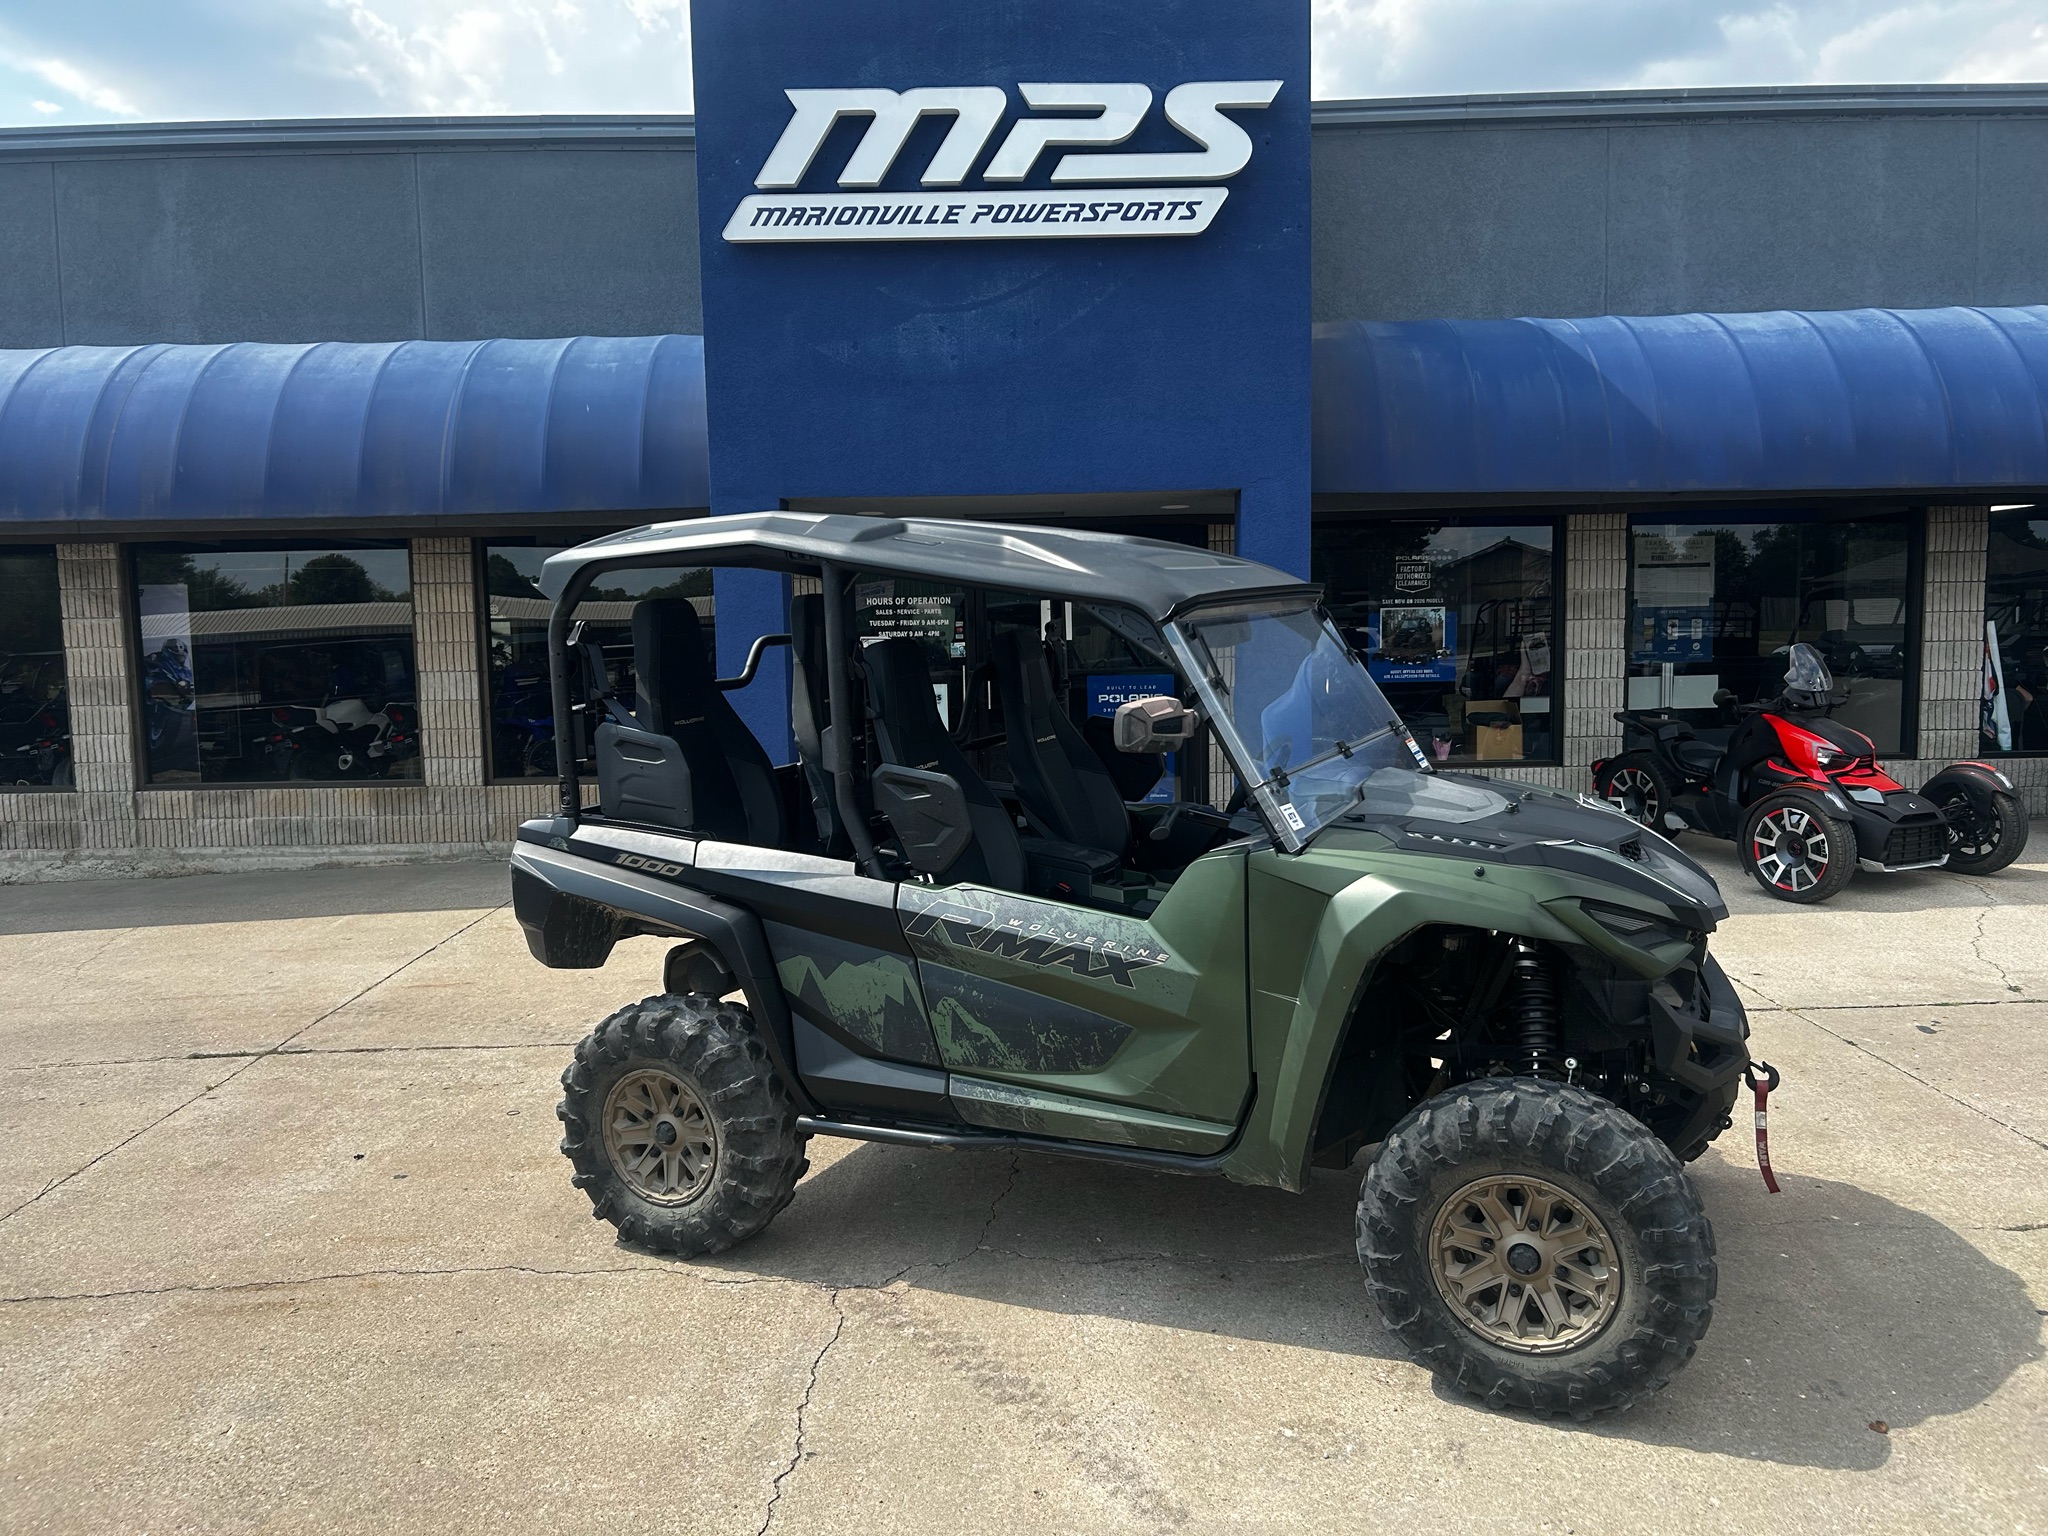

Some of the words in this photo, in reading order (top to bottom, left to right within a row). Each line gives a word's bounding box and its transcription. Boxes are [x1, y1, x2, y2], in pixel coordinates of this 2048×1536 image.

[754, 80, 1284, 188] MPS
[749, 204, 964, 227] MARIONVILLE
[969, 200, 1203, 224] POWERSPORTS
[1400, 565, 1426, 573] FACTORY
[895, 597, 905, 605] OF
[907, 596, 951, 605] OPERATION
[614, 853, 684, 876] 1000
[905, 900, 1165, 989] RMAX
[1758, 1141, 1769, 1167] WARN
